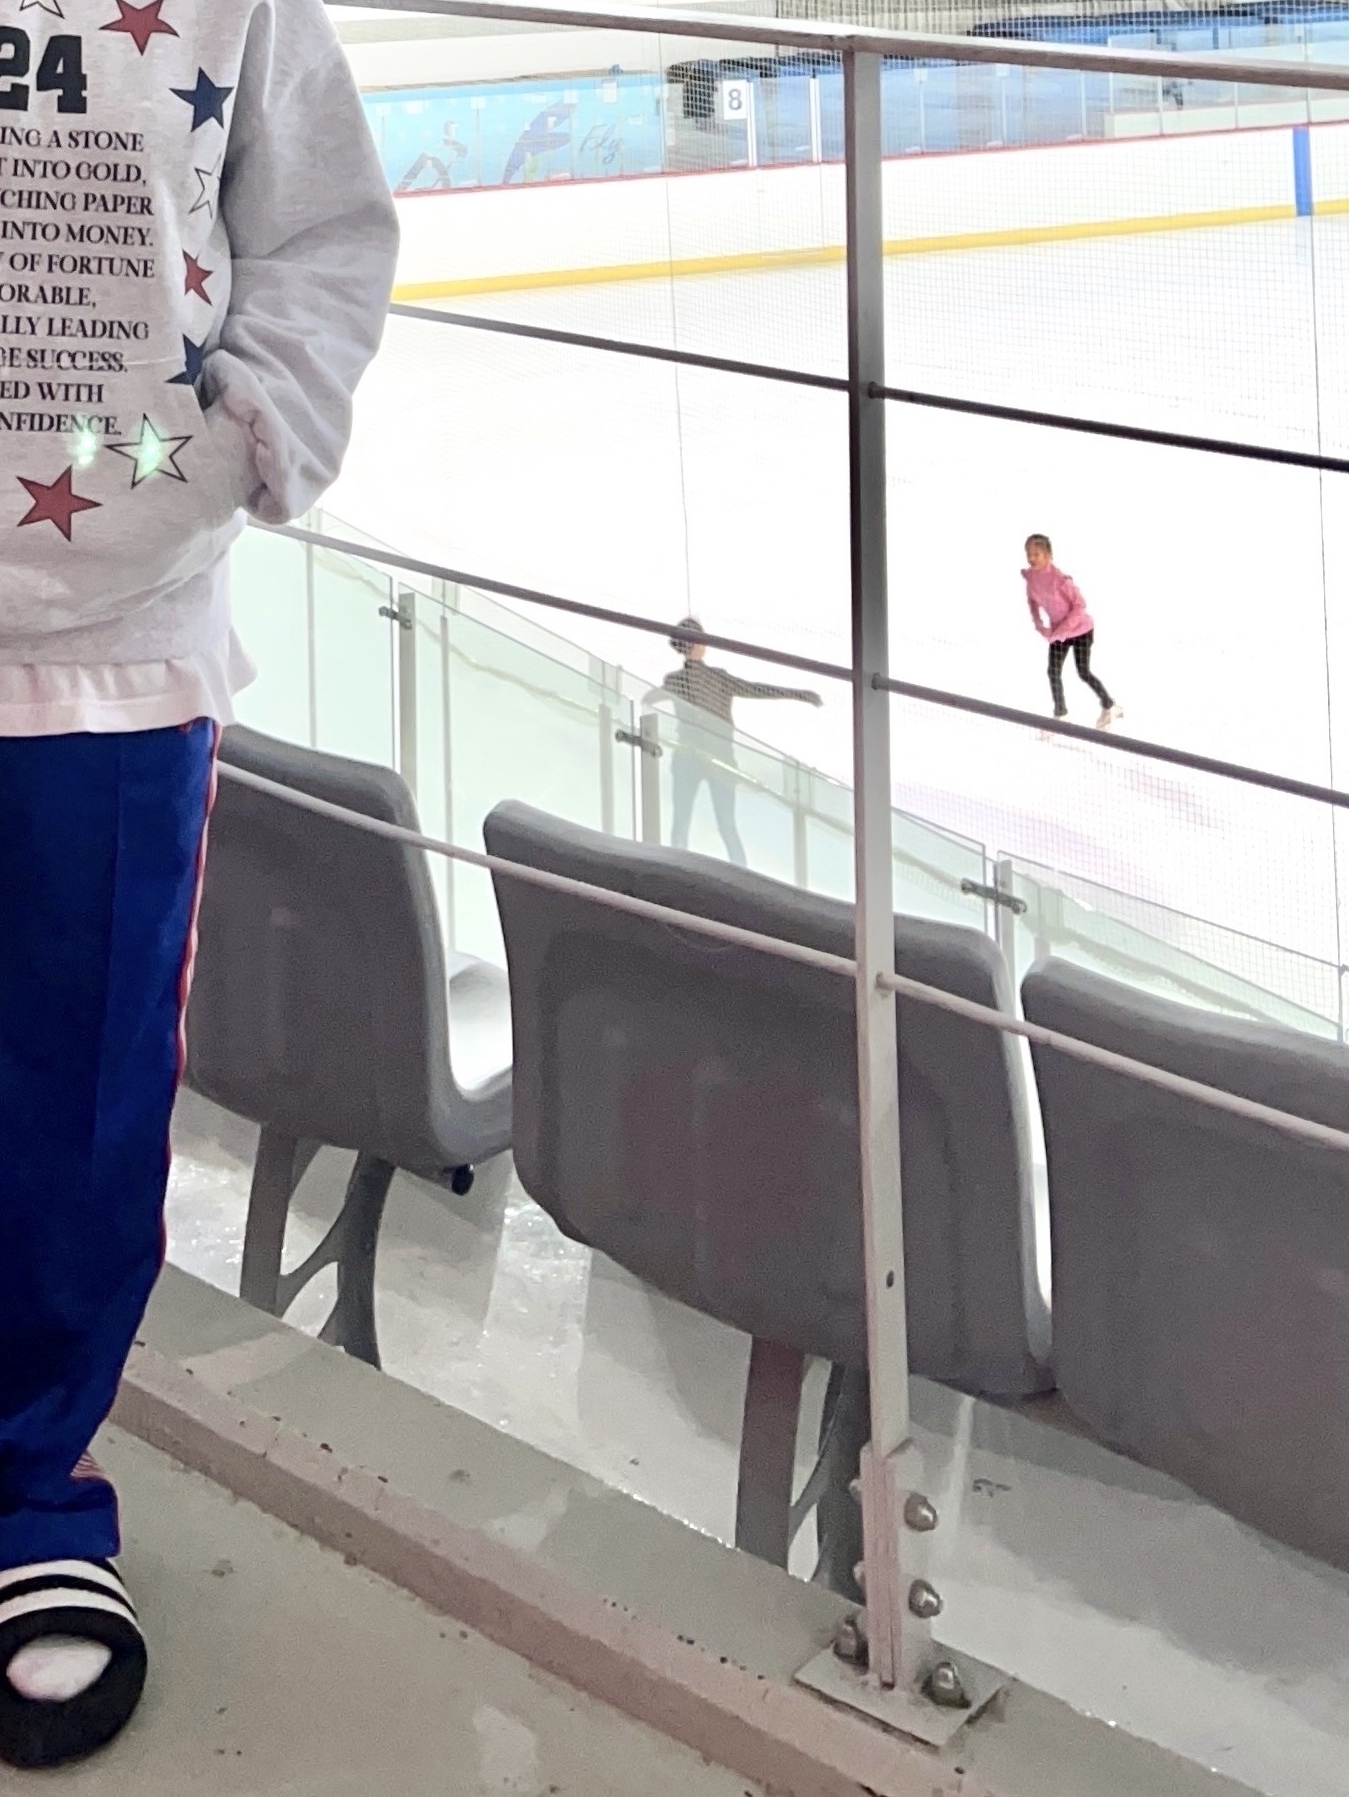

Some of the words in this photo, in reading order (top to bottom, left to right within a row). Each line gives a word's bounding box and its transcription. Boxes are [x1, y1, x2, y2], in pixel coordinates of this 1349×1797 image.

[728, 88, 743, 111] 8
[47, 129, 62, 148] A
[67, 130, 144, 152] STONE
[12, 158, 71, 180] INTO
[75, 160, 147, 187] GOLD,
[82, 192, 155, 216] PAPER
[1, 220, 60, 242] INTO
[65, 222, 154, 247] MONEY.
[8, 251, 42, 273] OF
[47, 253, 155, 279] FORTUNE
[47, 316, 150, 341] LEADING
[26, 348, 129, 373] SUCCESS.
[37, 381, 105, 404] WITH
